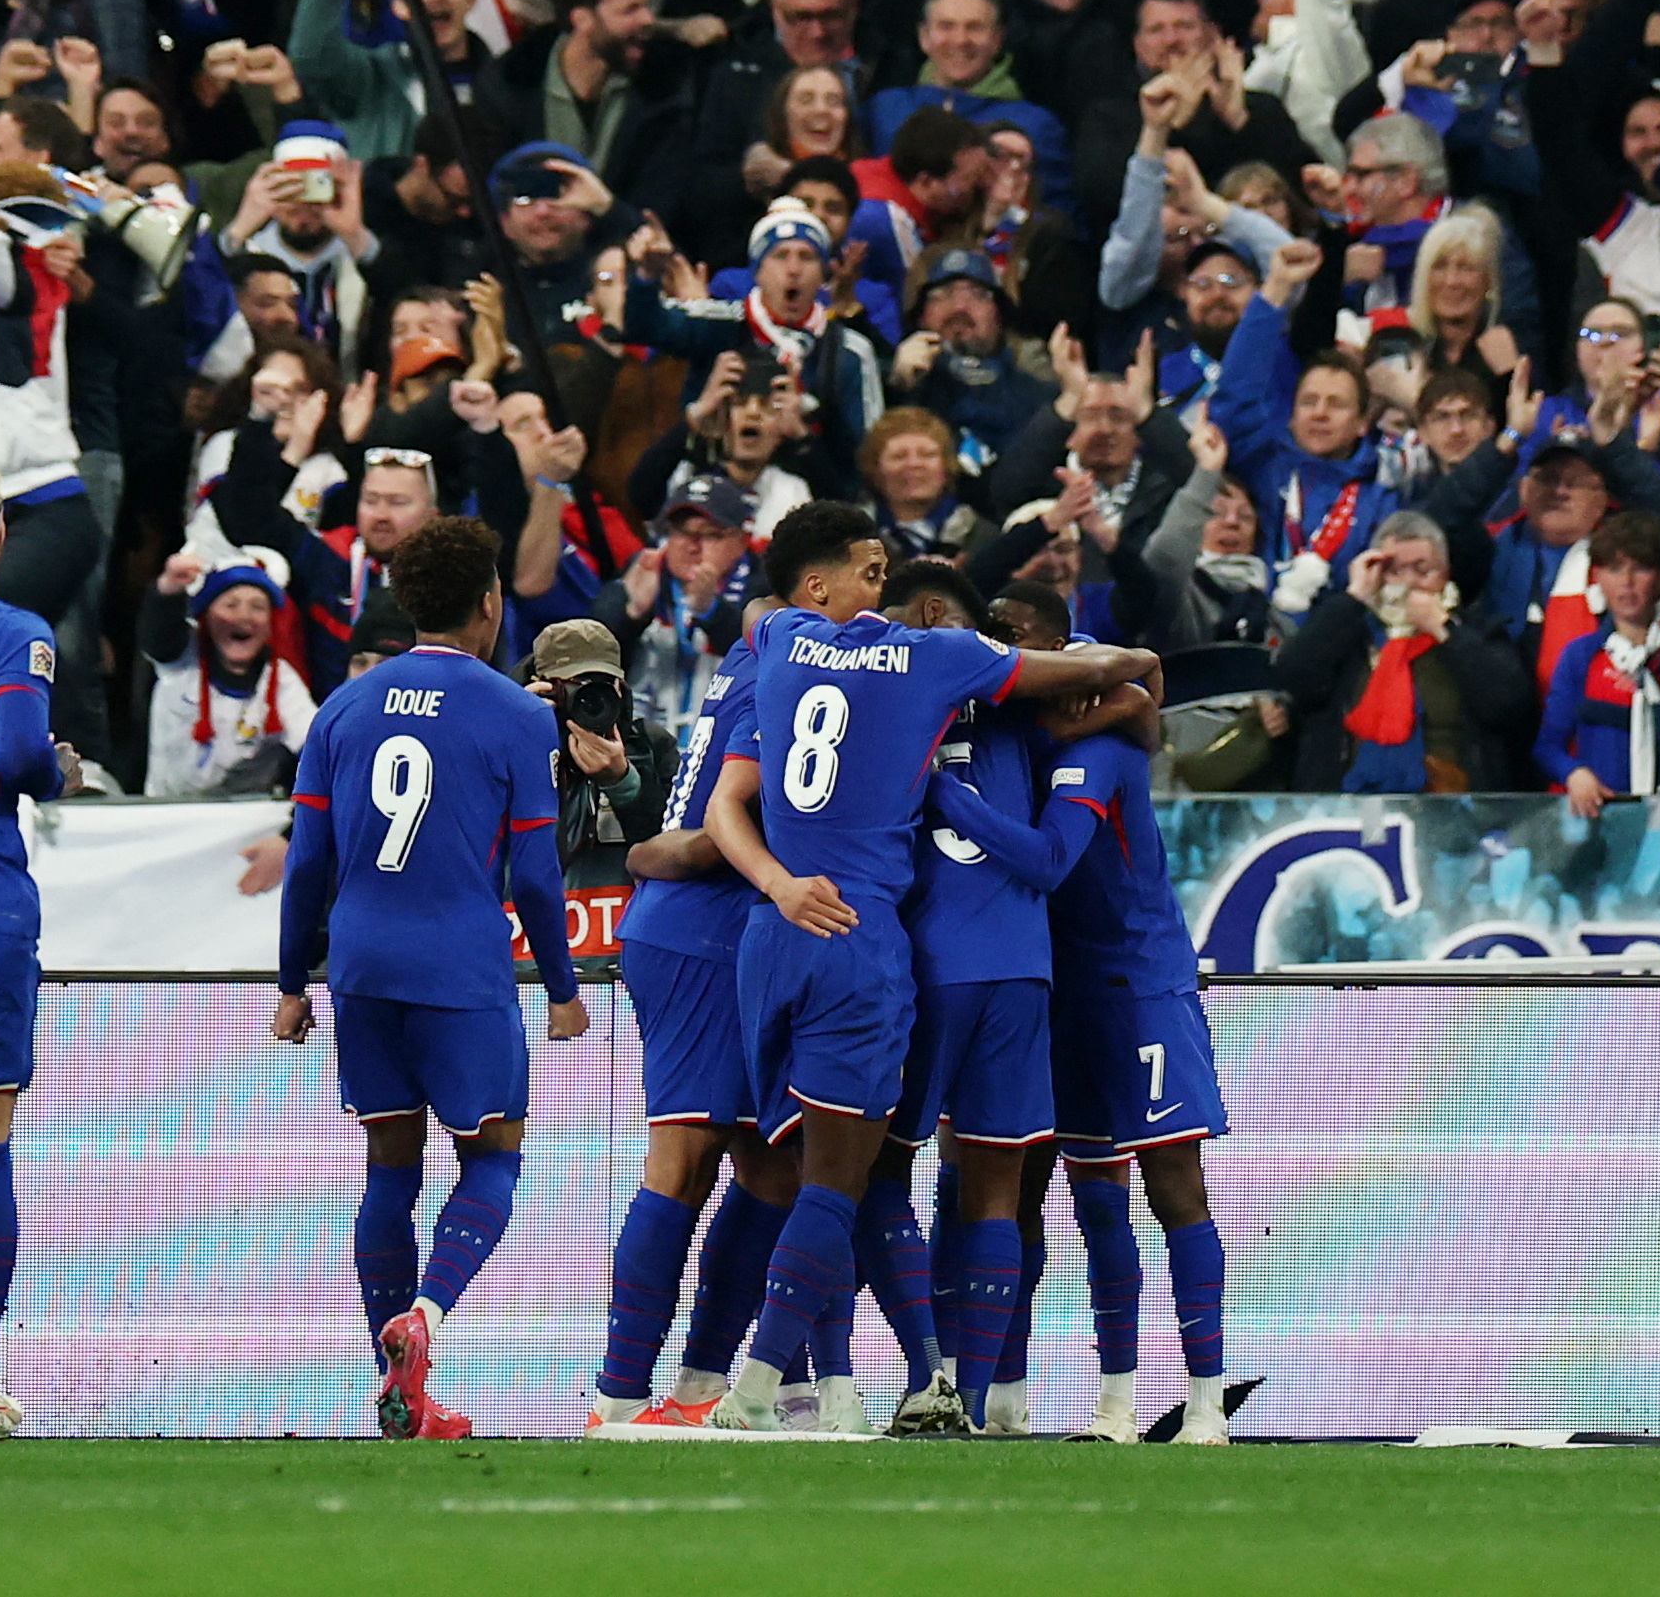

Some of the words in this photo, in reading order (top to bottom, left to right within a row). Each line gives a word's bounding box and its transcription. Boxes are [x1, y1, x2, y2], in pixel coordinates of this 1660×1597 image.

[787, 635, 911, 674] TCHOUAMENI
[383, 687, 444, 717] DOUE
[783, 683, 849, 813] 8
[371, 734, 433, 873] 9
[1137, 1042, 1165, 1101] 7
